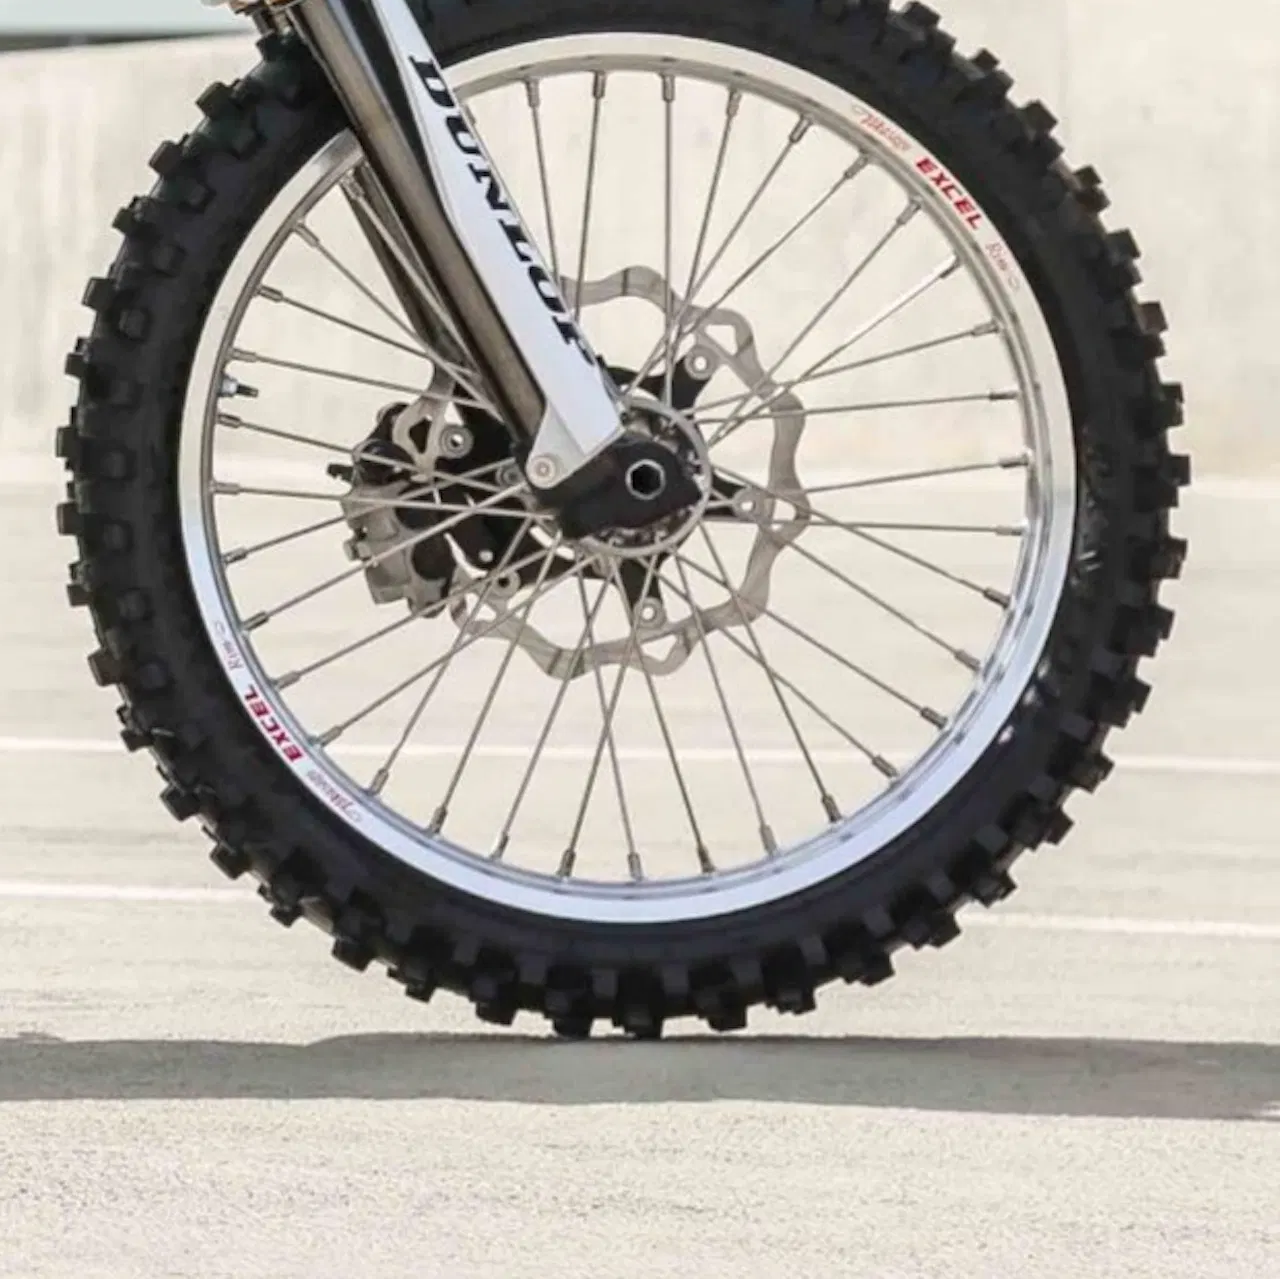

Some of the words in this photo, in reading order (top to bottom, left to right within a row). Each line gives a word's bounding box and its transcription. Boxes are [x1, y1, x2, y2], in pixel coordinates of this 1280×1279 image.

[408, 54, 596, 368] DUNLOP
[916, 157, 982, 230] EXCEL
[244, 684, 304, 762] EXCEL
